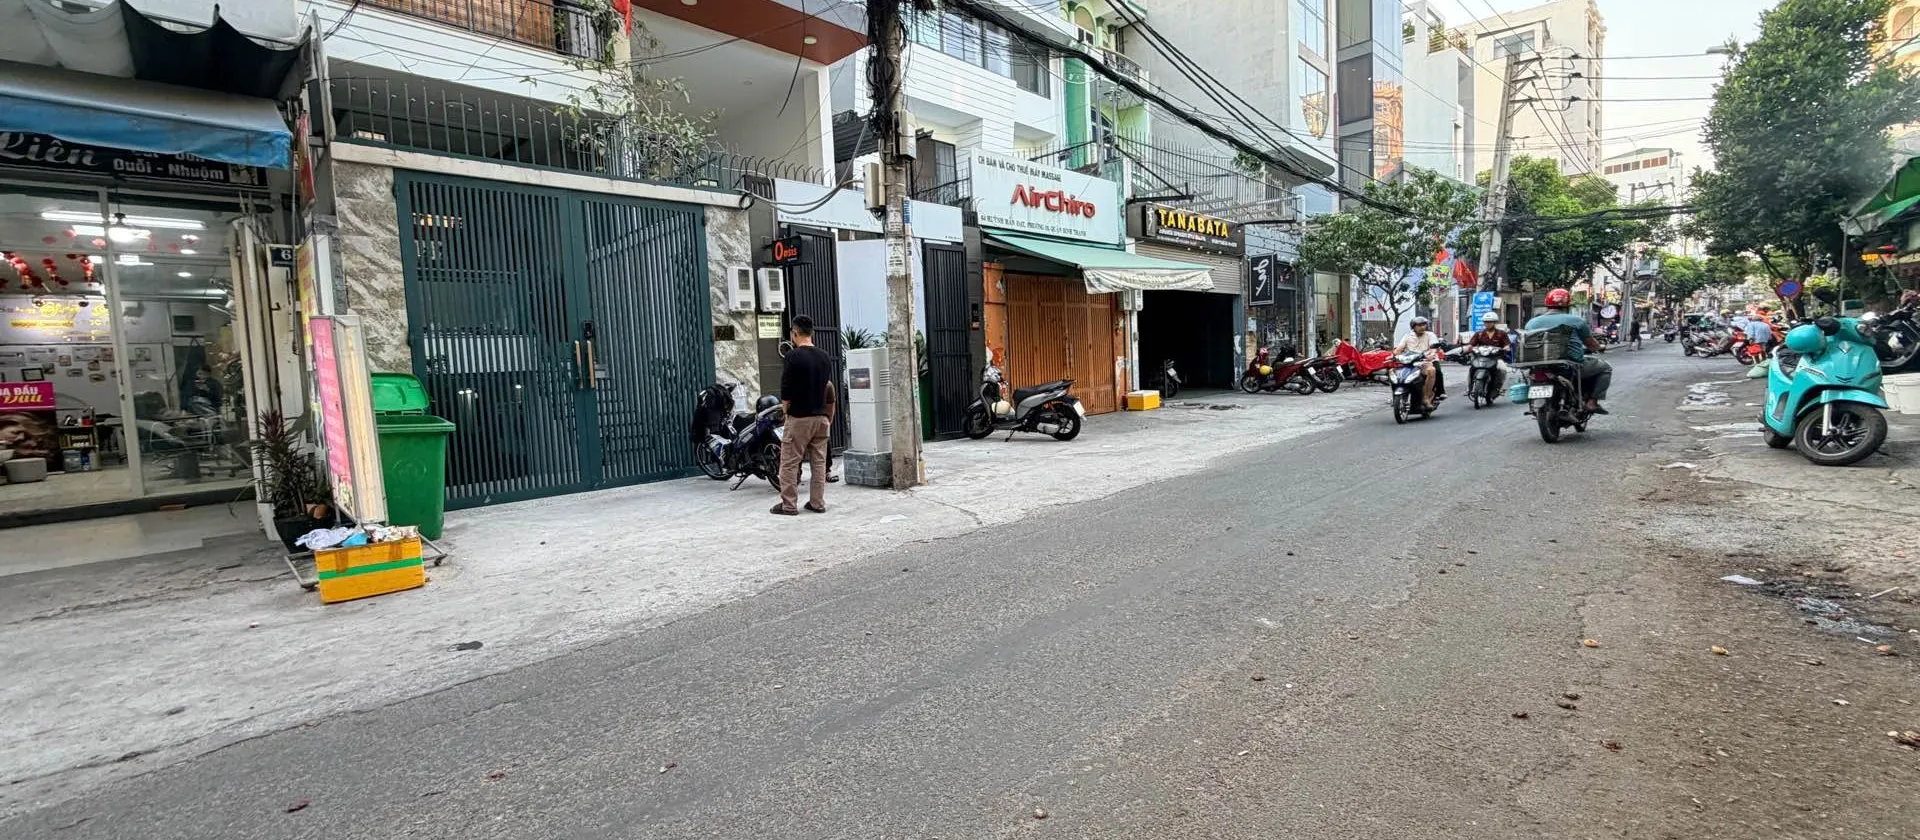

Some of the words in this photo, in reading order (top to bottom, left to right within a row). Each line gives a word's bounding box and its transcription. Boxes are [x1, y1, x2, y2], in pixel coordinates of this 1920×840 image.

[1010, 183, 1096, 218] AirChiro
[1158, 208, 1230, 239] TANABATA
[774, 241, 798, 261] Oasis
